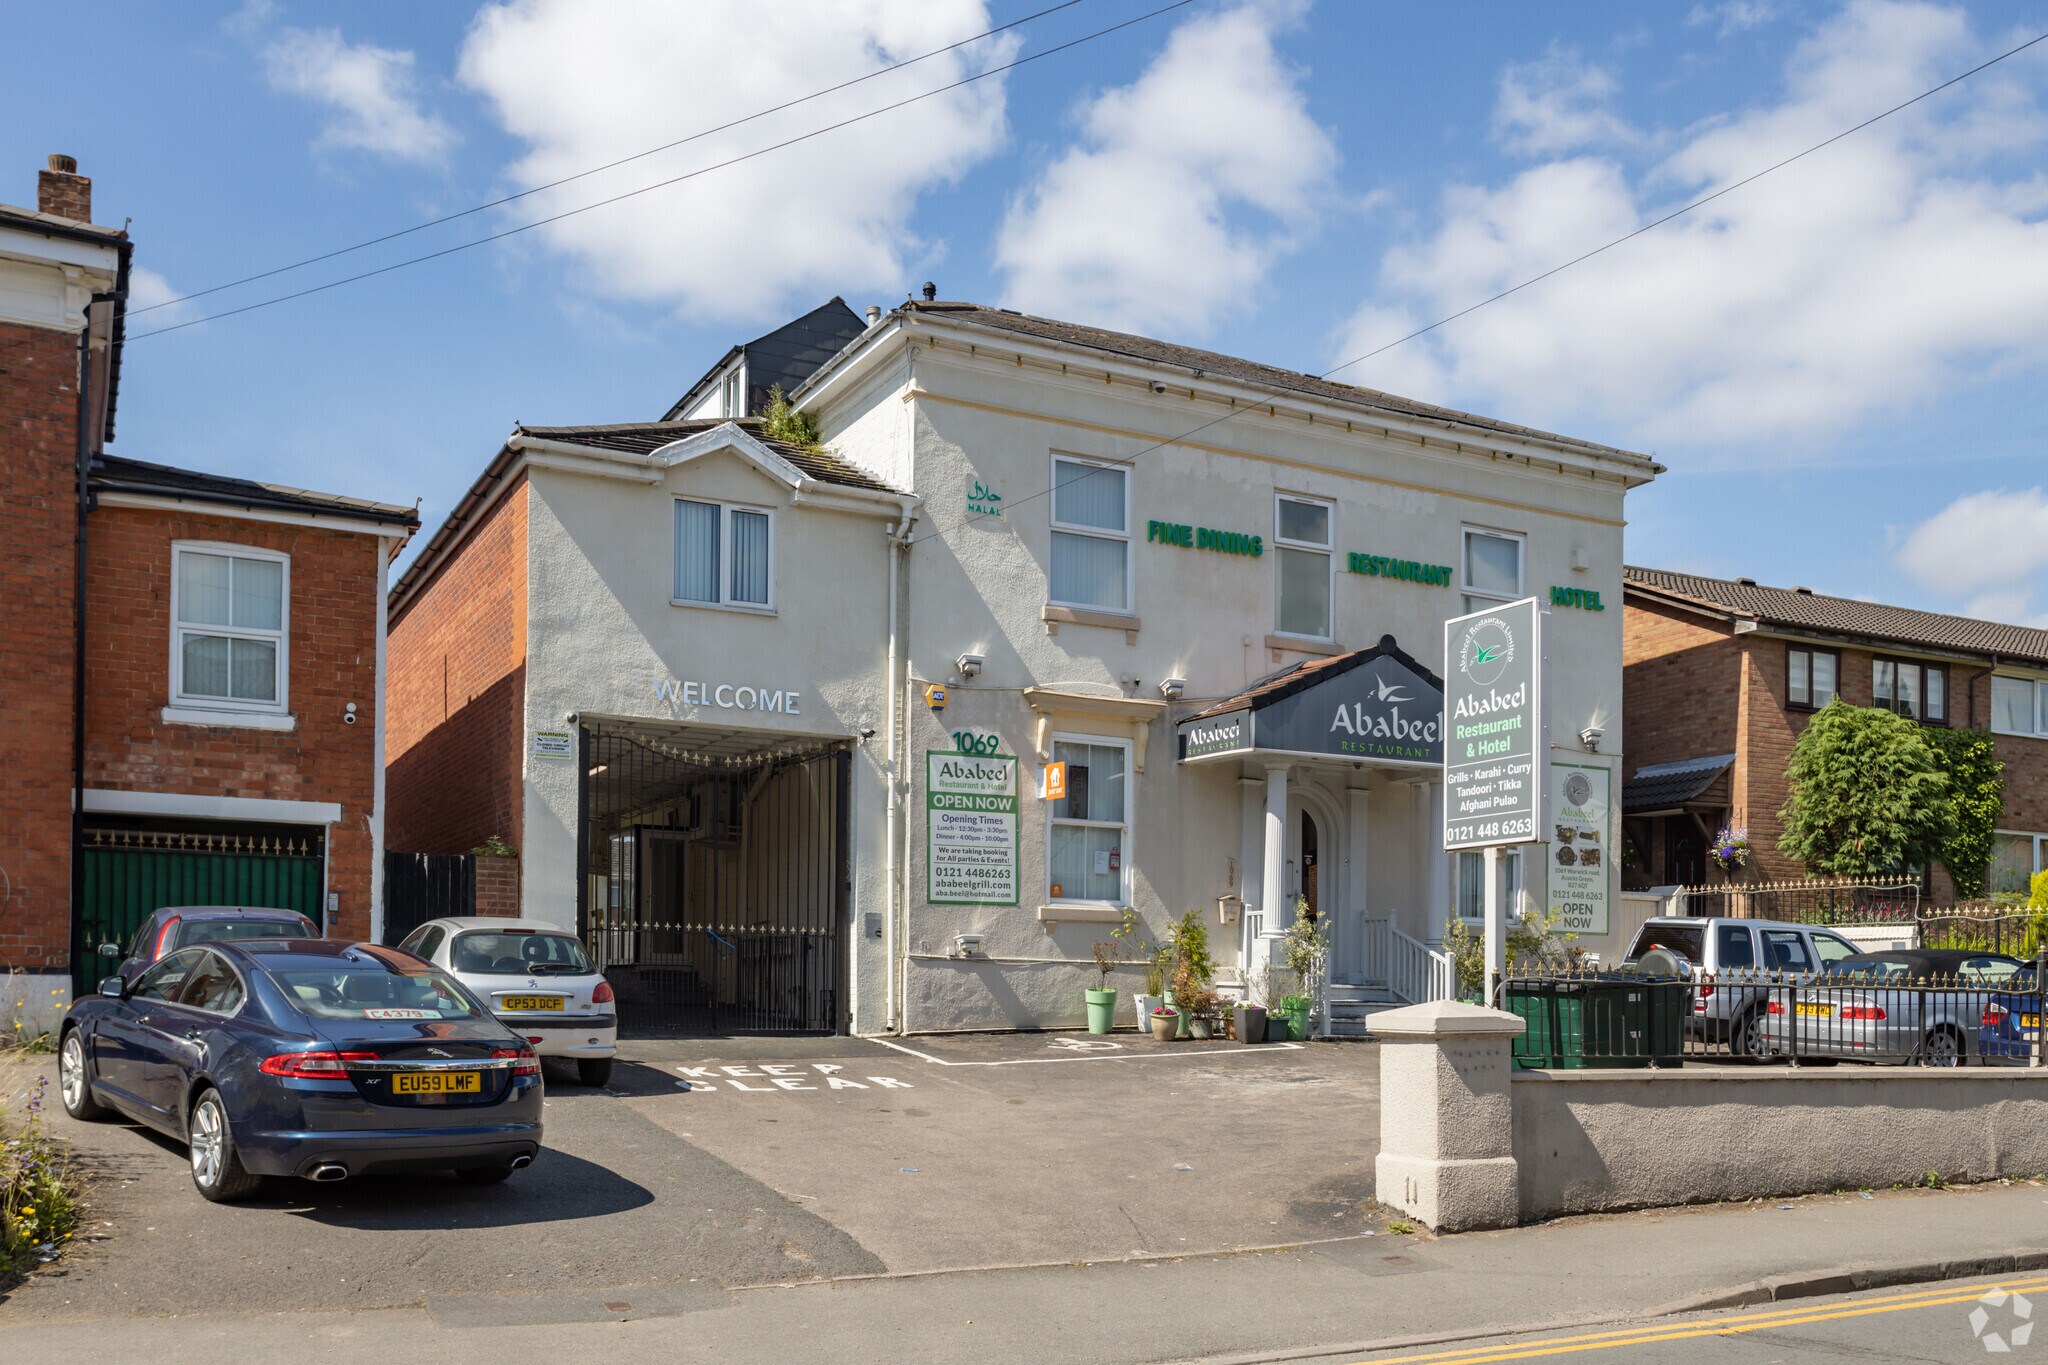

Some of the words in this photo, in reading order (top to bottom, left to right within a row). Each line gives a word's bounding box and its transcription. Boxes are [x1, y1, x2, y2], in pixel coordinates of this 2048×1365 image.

[967, 480, 1001, 501] حلال
[967, 503, 1001, 516] HALAL
[1147, 520, 1193, 547] FINE
[1196, 526, 1263, 557] DINING
[1348, 552, 1453, 587] RESTAURANT
[1550, 586, 1604, 611] HOTEL
[653, 677, 800, 715] WELCOME
[1453, 682, 1526, 720] Ababeel
[1329, 702, 1445, 744] Ababeel
[1456, 714, 1522, 740] Restaurant
[952, 731, 999, 755] 1069
[1341, 740, 1431, 758] RESTAURANT
[1466, 743, 1475, 758] &
[1479, 736, 1510, 756] Hotel
[940, 762, 1007, 781] Ababeel
[1448, 770, 1469, 784] Grills
[1475, 766, 1501, 781] Karahi
[1507, 762, 1531, 776] Curry
[940, 780, 979, 790] Restaurant
[988, 783, 1007, 791] Hotel
[1456, 783, 1492, 798] Tandoori
[1498, 779, 1522, 791] Tikka
[933, 794, 973, 809] OPEN
[976, 797, 1012, 811] NOW
[1460, 797, 1492, 813] Afghani
[1493, 795, 1518, 807] Pulao
[942, 814, 977, 825] Opening
[979, 816, 1003, 825] Times
[1447, 825, 1473, 841] 0121
[1477, 822, 1499, 838] 448
[1502, 818, 1532, 835] 6263
[962, 848, 982, 856] taking
[936, 867, 962, 877] 0121
[965, 868, 1011, 878] 4486263
[936, 879, 1011, 890] ababeelgrill.com
[936, 890, 1011, 898] aba.beel@hotmail.com
[1553, 890, 1570, 899] 0121
[1571, 891, 1584, 899] 448
[1586, 892, 1603, 901] 6263
[1562, 902, 1593, 915] OPEN
[1564, 917, 1592, 929] NOW
[507, 998, 536, 1009] CP53
[539, 999, 559, 1009] DCF
[676, 1063, 844, 1077] KEEP
[399, 1075, 441, 1091] EU59
[445, 1074, 474, 1090] LMF
[674, 1076, 914, 1092] CLEAR
